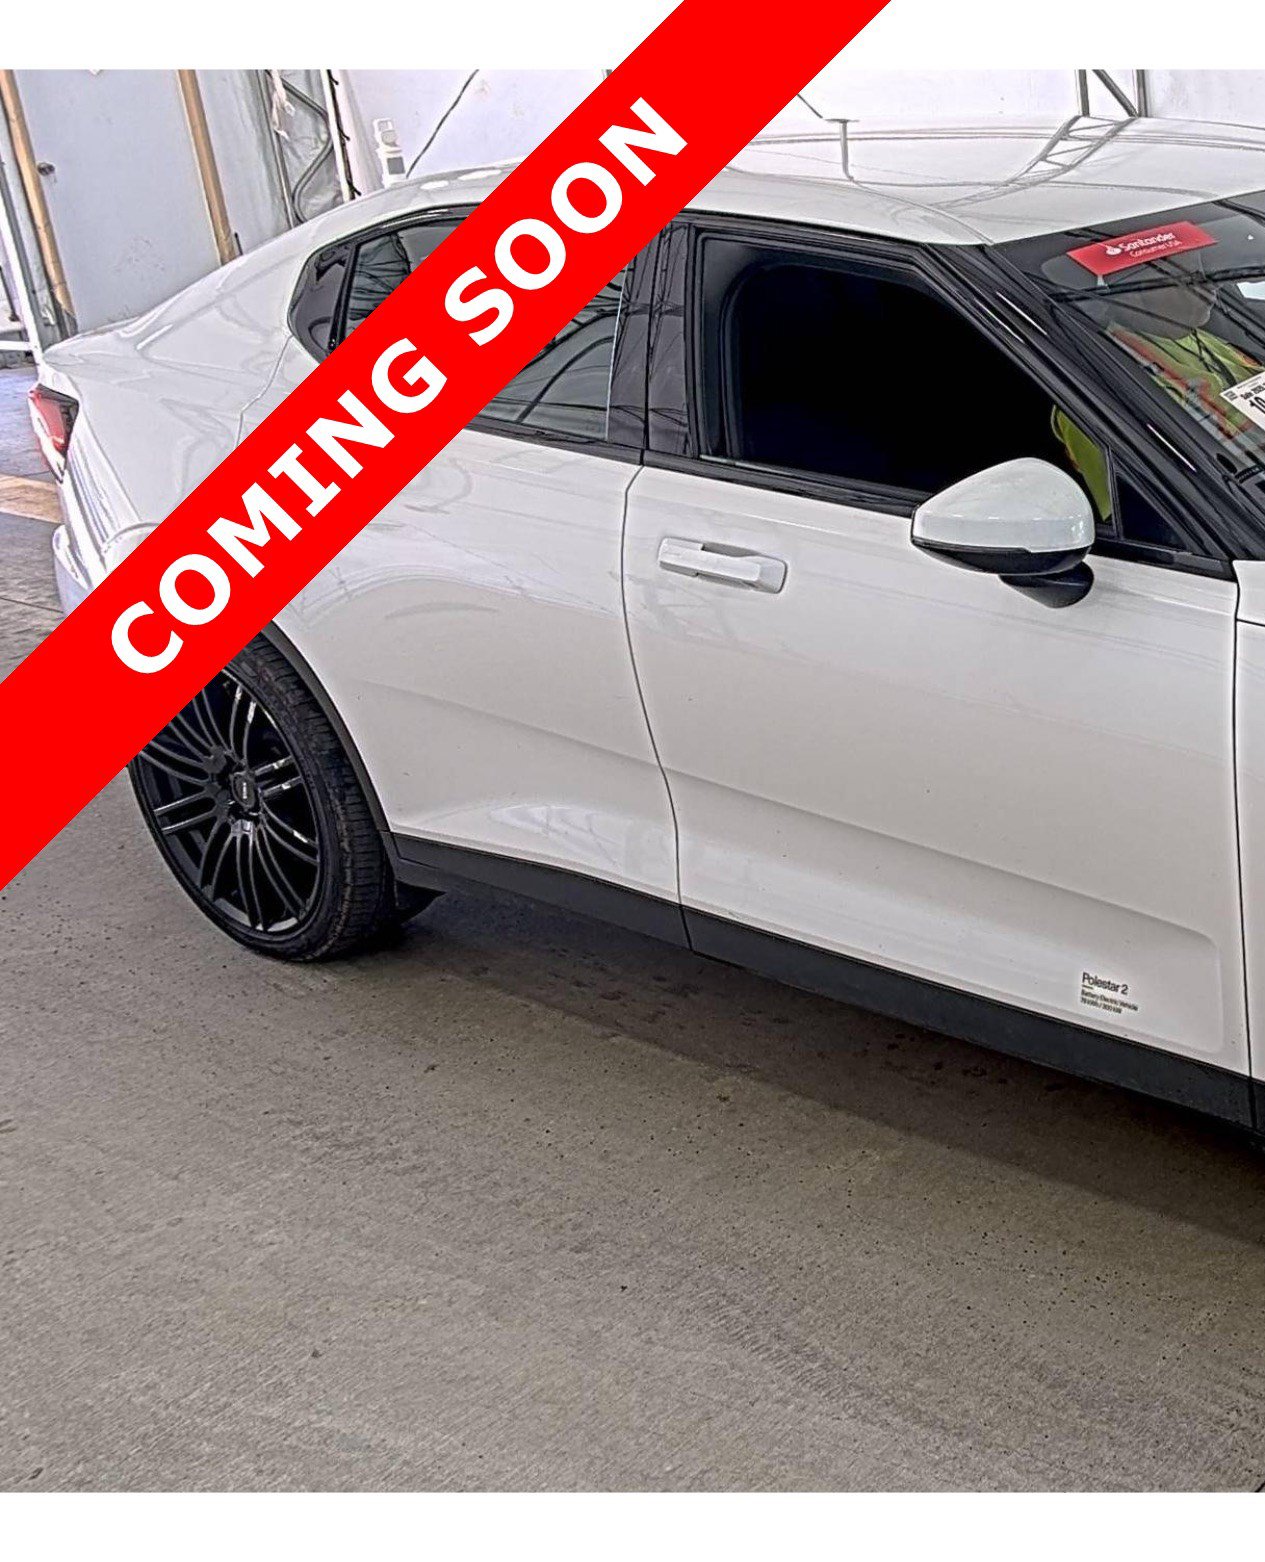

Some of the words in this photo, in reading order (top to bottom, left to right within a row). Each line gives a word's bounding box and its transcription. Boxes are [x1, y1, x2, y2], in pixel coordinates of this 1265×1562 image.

[1118, 232, 1176, 252] Santander
[1082, 971, 1120, 993] Polestar
[1120, 983, 1129, 995] 2
